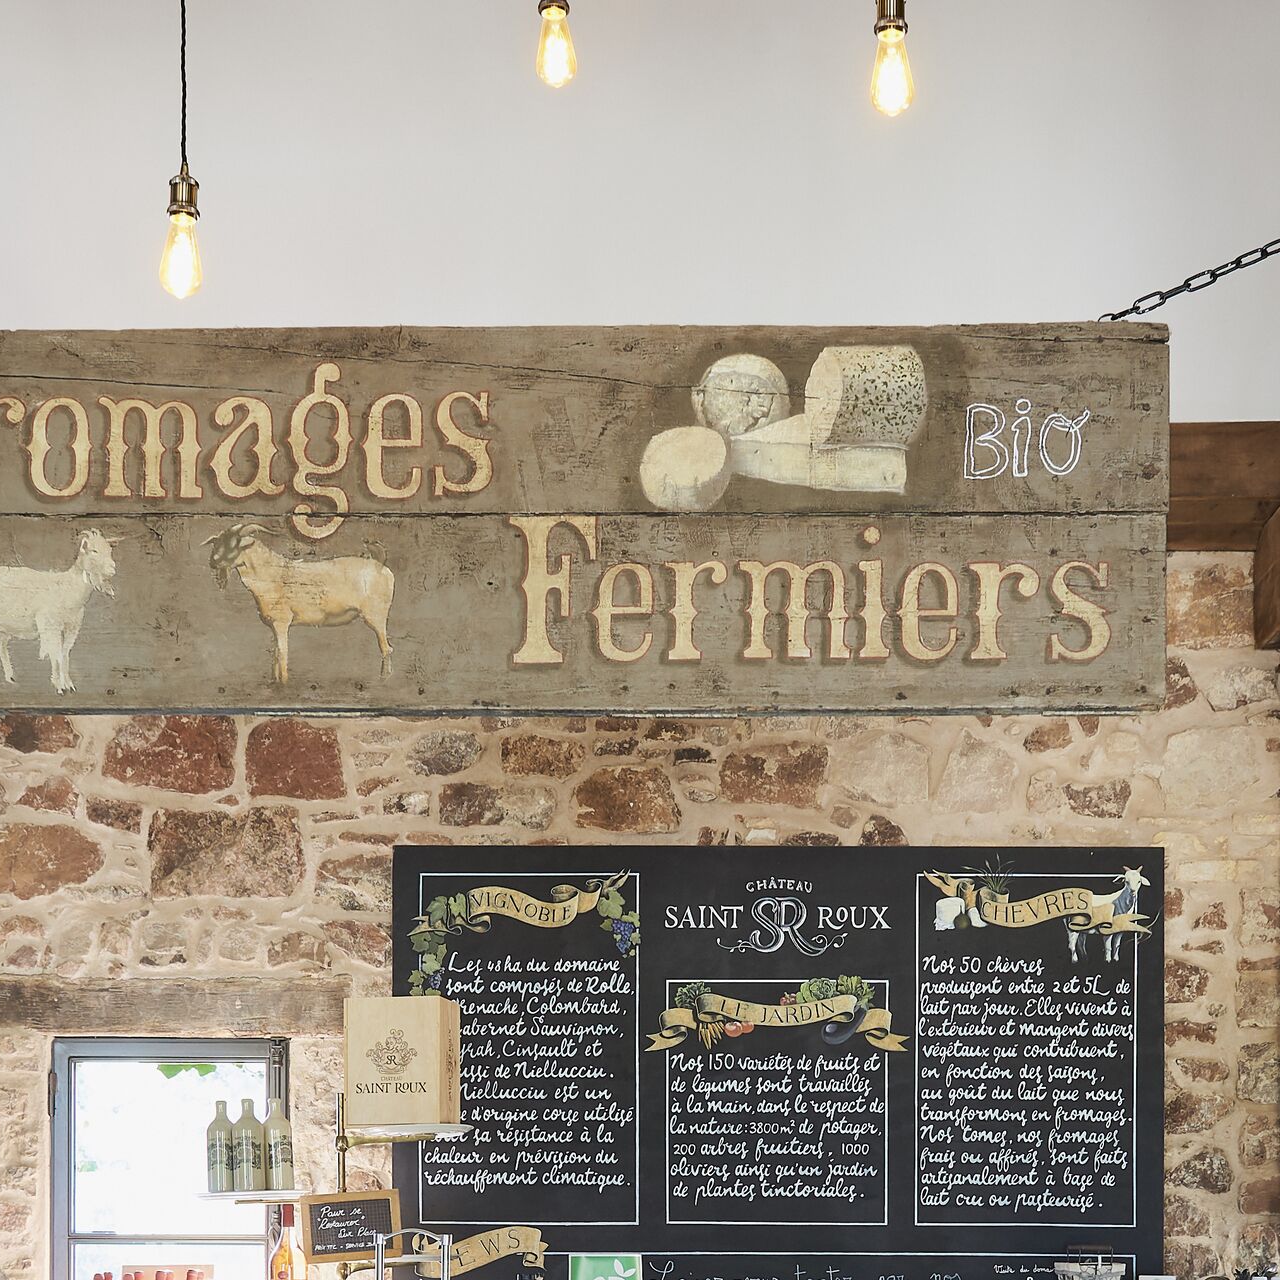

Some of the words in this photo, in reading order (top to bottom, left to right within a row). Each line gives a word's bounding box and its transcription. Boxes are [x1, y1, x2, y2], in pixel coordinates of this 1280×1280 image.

[964, 403, 1093, 481] Bio
[511, 515, 1114, 665] Fermiers
[746, 877, 813, 892] CHÂTEAU
[469, 890, 572, 924] VIGNOBLE
[665, 905, 743, 929] SAINT
[818, 905, 891, 929] ROUX
[982, 890, 1088, 924] CHEVRES
[922, 956, 956, 974] Nos
[960, 956, 981, 974] 50
[987, 956, 1044, 974] chèvres
[921, 980, 1002, 1003] produisent
[1008, 981, 1045, 994] entre
[1053, 983, 1059, 994] 2
[1062, 980, 1079, 994] et
[1083, 975, 1110, 995] 5L
[1116, 979, 1131, 994] de
[721, 999, 747, 1019] LE
[761, 1001, 835, 1024] JARDIN
[920, 997, 949, 1016] lait
[951, 1004, 980, 1023] par
[1025, 998, 1063, 1020] Elles
[1065, 1001, 1116, 1016] vivent
[1122, 999, 1132, 1016] à
[919, 1018, 996, 1037] l'extérieur
[1000, 1023, 1015, 1036] et
[1020, 1022, 1089, 1045] mangent
[1092, 1020, 1134, 1041] divers
[671, 1054, 703, 1072] Nos
[709, 1053, 735, 1071] 150
[738, 1055, 794, 1074] variétés
[797, 1056, 812, 1072] de
[815, 1053, 861, 1077] fruits
[864, 1054, 881, 1072] et
[356, 1082, 390, 1094] SAINT
[394, 1081, 427, 1094] ROUX
[671, 1075, 687, 1093] de
[692, 1075, 752, 1100] légumes
[756, 1075, 793, 1096] sont
[799, 1074, 872, 1096] travaillés
[671, 1097, 681, 1113] à
[686, 1094, 704, 1113] la
[757, 1097, 792, 1115] dans
[794, 1095, 809, 1113] le
[811, 1101, 867, 1121] respect
[870, 1095, 885, 1113] de
[670, 1116, 686, 1135] la
[798, 1118, 814, 1135] de
[820, 1117, 882, 1142] potager,
[424, 1146, 484, 1164] chaleur
[490, 1153, 510, 1164] en
[514, 1150, 592, 1172] prévision
[595, 1148, 619, 1164] du
[674, 1143, 696, 1156] 200
[701, 1137, 748, 1157] arbres
[755, 1137, 833, 1162] fruitiers,
[841, 1143, 869, 1156] 1000
[424, 1166, 538, 1193] réchauffement
[542, 1165, 631, 1193] climatique.
[671, 1158, 730, 1179] oliviers
[735, 1163, 771, 1179] ainsi
[775, 1161, 822, 1184] qu'un
[826, 1158, 878, 1185] jardin
[673, 1179, 688, 1197] de
[695, 1177, 756, 1205] plantes
[761, 1176, 865, 1201] tinctoriales.
